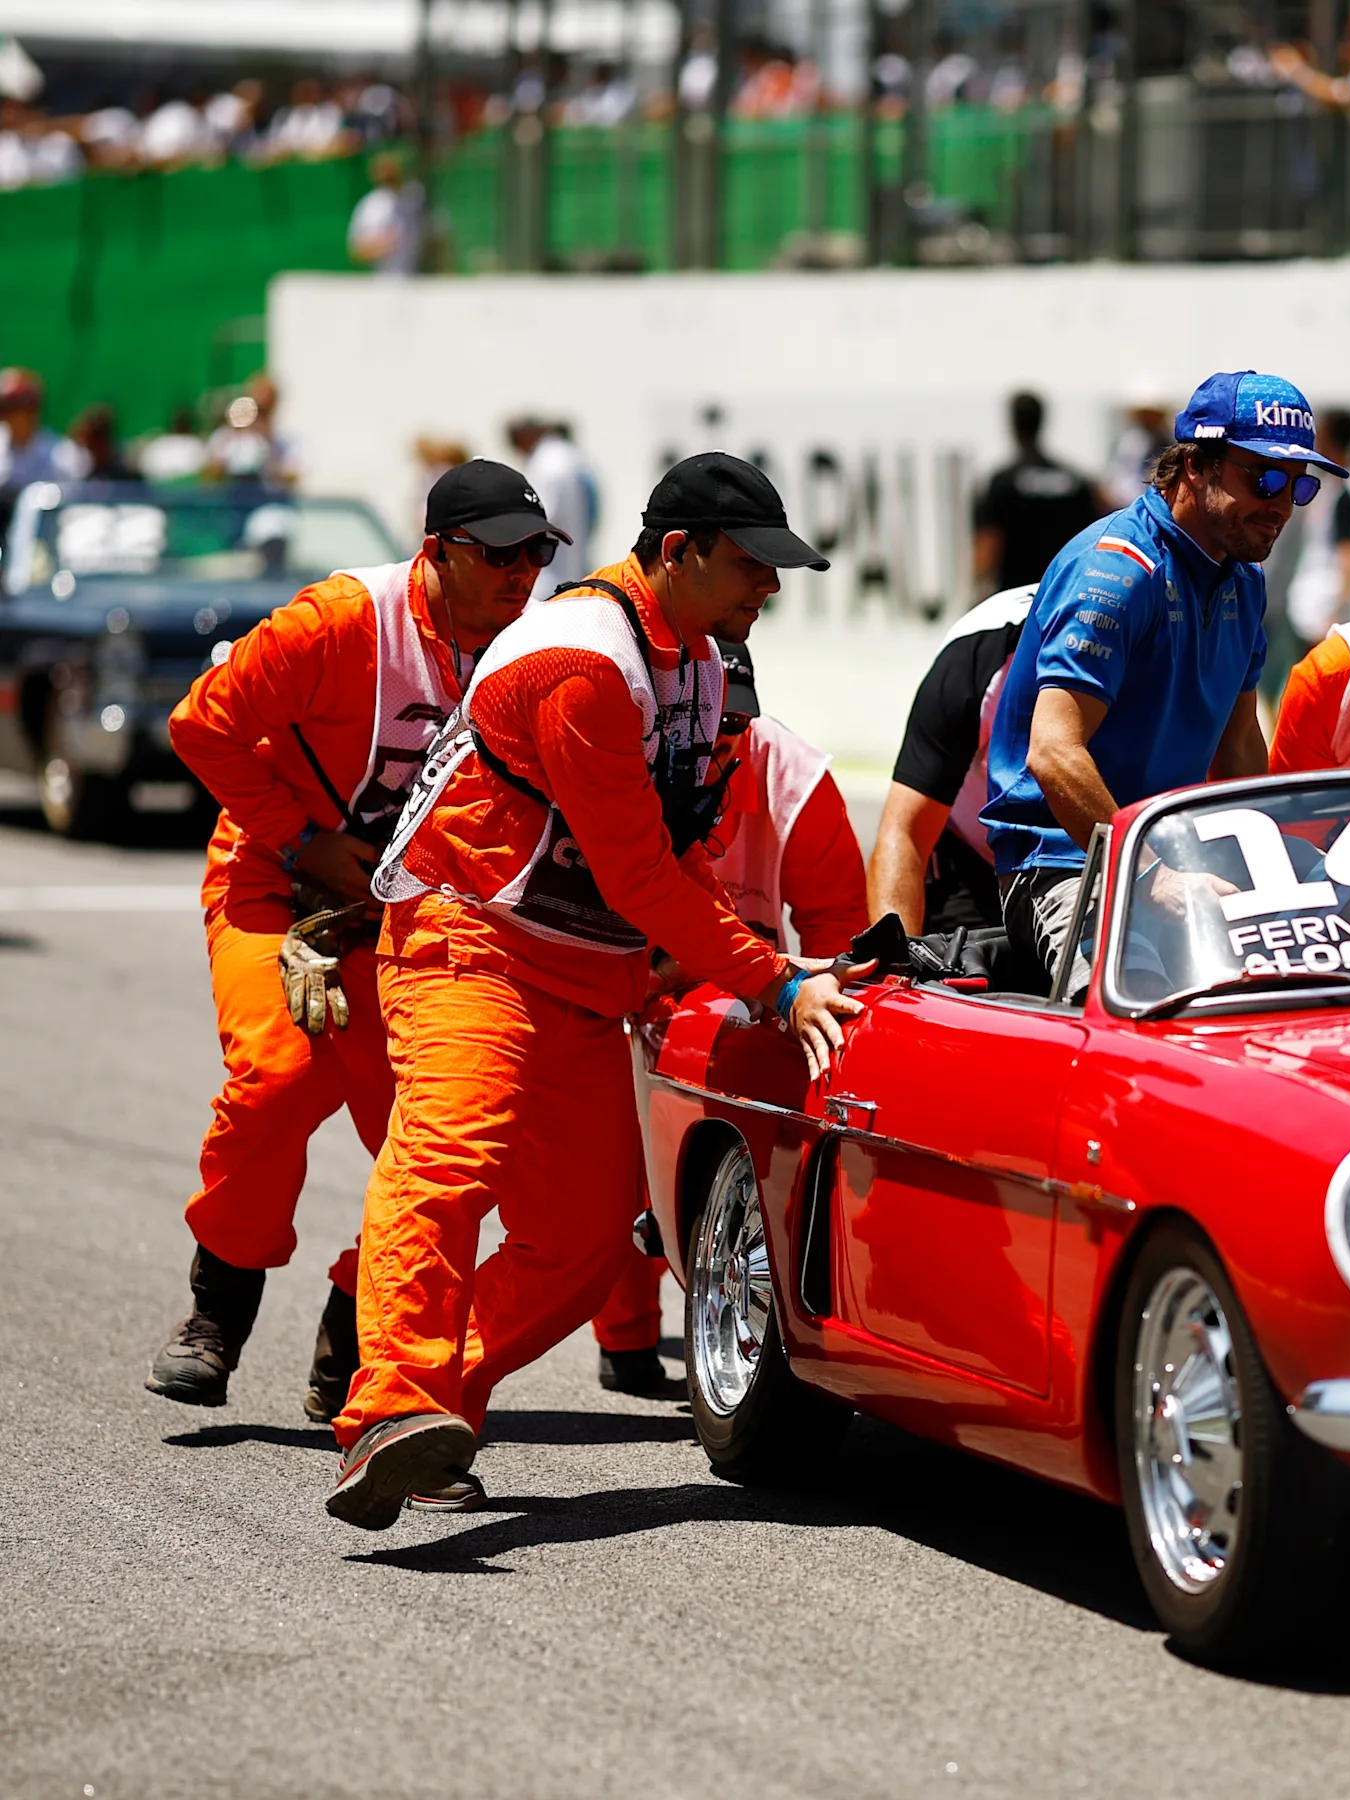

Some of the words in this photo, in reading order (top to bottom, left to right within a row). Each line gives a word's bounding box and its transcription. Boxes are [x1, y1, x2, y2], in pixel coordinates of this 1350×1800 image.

[1078, 592, 1127, 611] E-TECH
[1088, 587, 1121, 600] RENAULT
[1078, 609, 1116, 630] DUPONT
[1078, 639, 1113, 660] BWT
